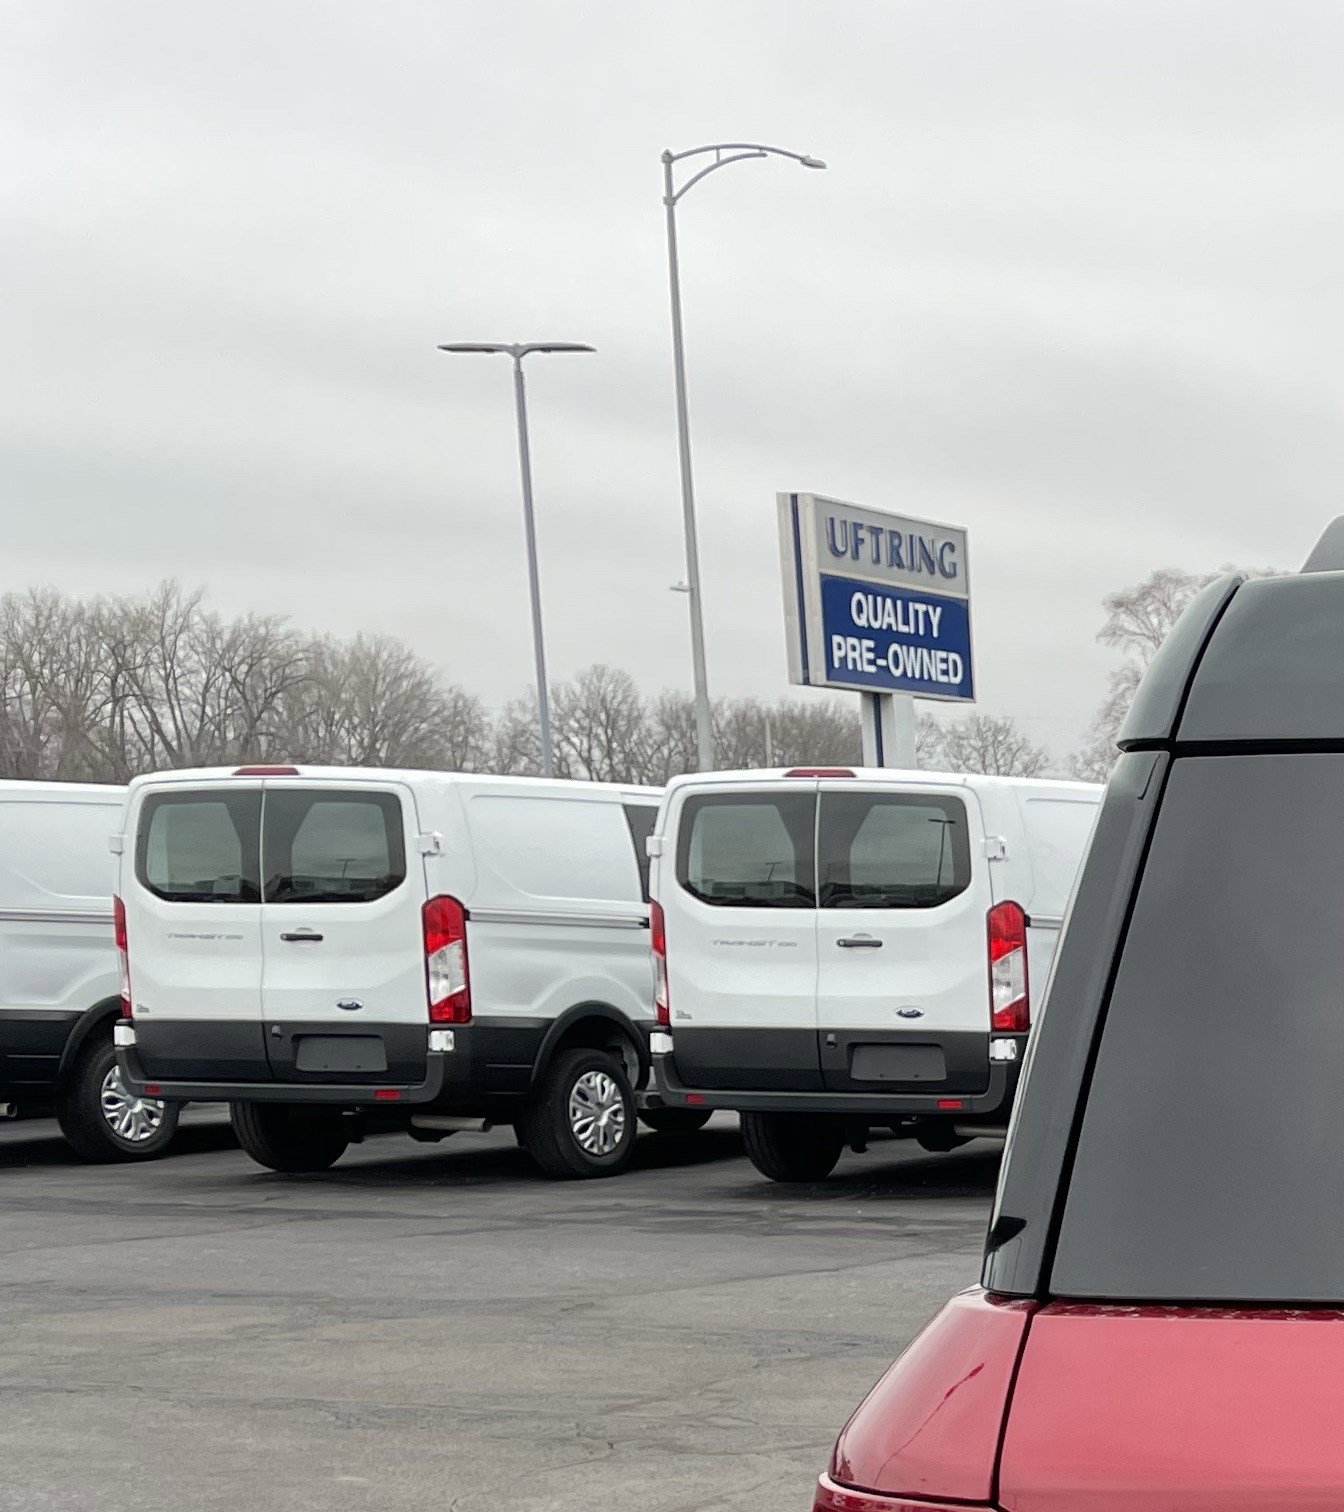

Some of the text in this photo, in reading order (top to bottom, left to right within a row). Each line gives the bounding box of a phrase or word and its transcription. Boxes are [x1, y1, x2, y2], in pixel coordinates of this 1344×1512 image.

[826, 517, 958, 580] UFTRING
[850, 591, 943, 638] QUALITY
[831, 634, 964, 685] PRE-OWNED
